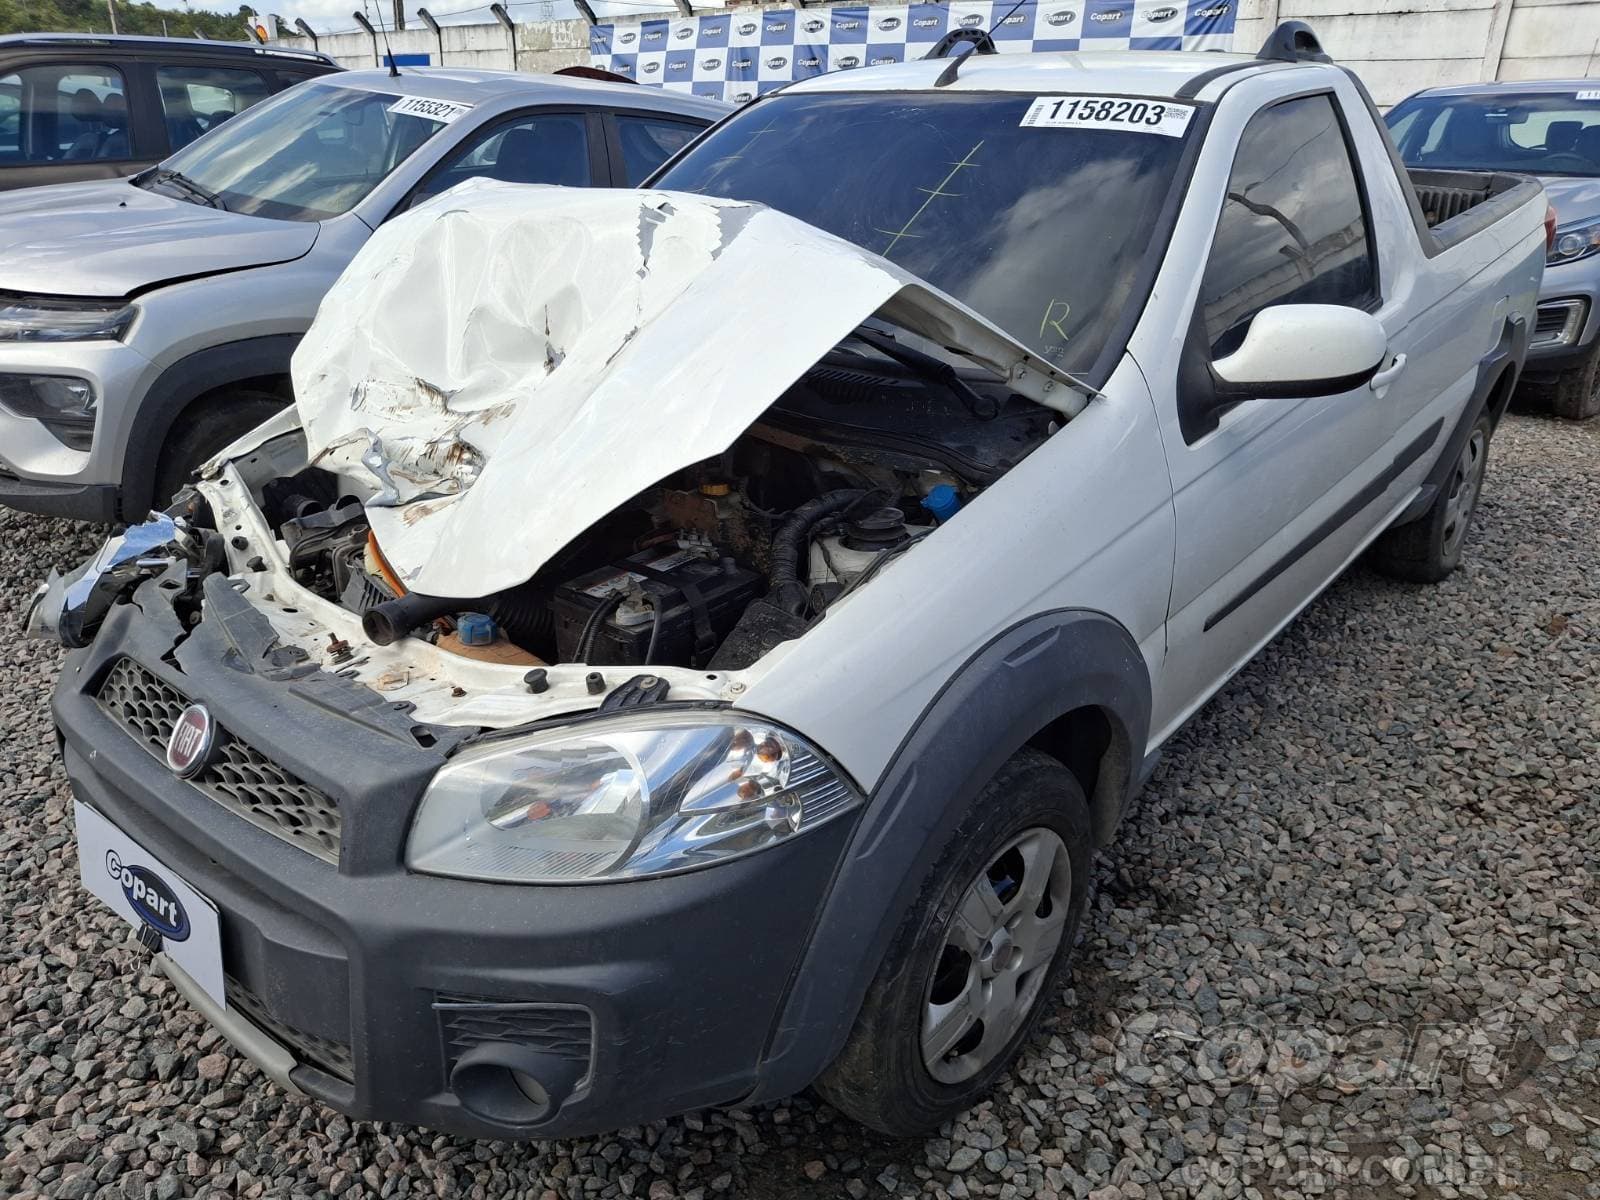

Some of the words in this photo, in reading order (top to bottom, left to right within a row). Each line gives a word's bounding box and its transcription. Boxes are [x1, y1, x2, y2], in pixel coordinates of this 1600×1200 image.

[1043, 11, 1072, 22] Copart
[1090, 10, 1122, 22] Copart
[1140, 8, 1173, 21] Copart
[1194, 6, 1228, 18] Copart
[873, 19, 898, 29] Copart
[913, 17, 938, 28] Copart
[954, 15, 980, 26] Copart
[997, 13, 1025, 25] Copart
[766, 23, 787, 33] Copart
[836, 20, 859, 30] Copart
[644, 32, 662, 40] Copart
[702, 27, 722, 36] Copart
[668, 61, 687, 70] Copart
[700, 60, 720, 69] Copart
[732, 58, 752, 68] Copart
[765, 58, 785, 68] Copart
[798, 57, 820, 68] Copart
[402, 98, 456, 118] 1155321
[1050, 99, 1165, 125] 1158203
[1039, 298, 1070, 341] R
[174, 720, 202, 758] FIAT
[106, 849, 178, 928] Copart
